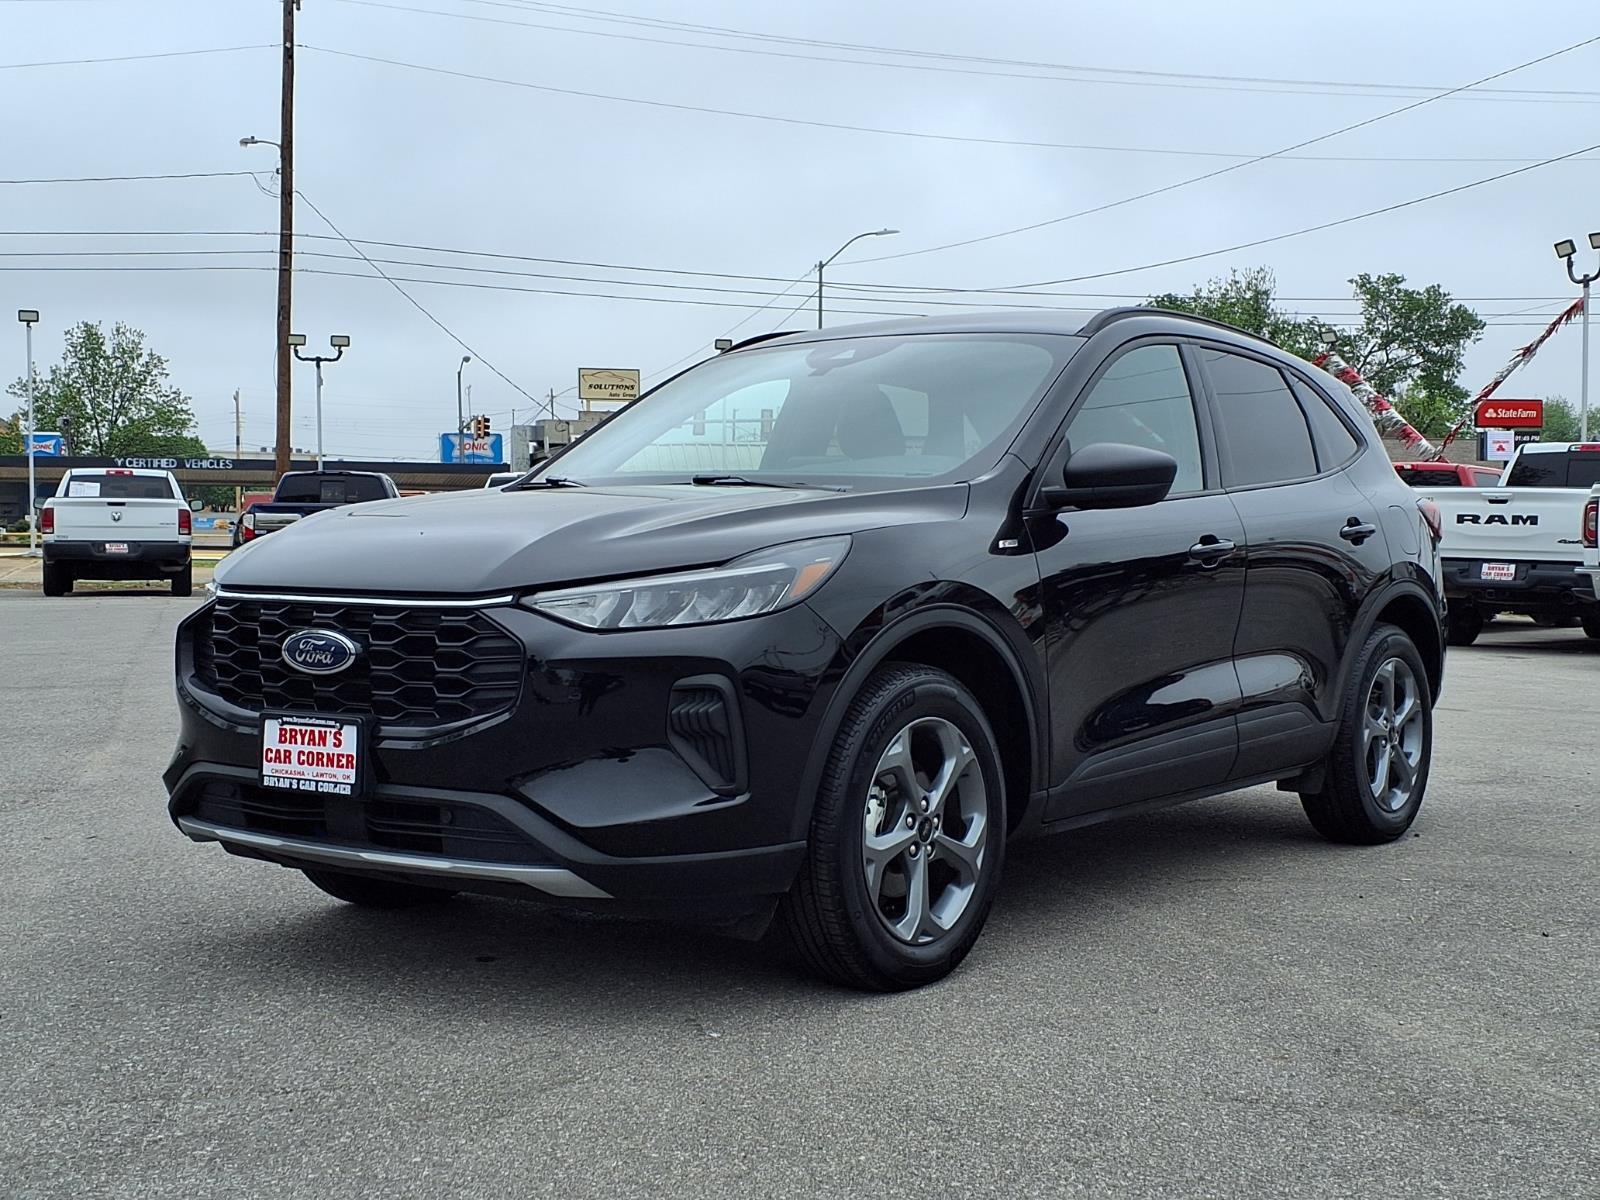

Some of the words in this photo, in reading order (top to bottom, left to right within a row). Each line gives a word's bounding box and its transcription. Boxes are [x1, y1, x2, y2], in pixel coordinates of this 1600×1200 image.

[125, 458, 177, 468] CERTIFIED
[185, 459, 233, 469] VEHICLES
[1456, 514, 1539, 525] RAM
[295, 638, 336, 664] Ford
[278, 727, 343, 748] BRYAN'S
[264, 748, 292, 765] CAR
[297, 750, 355, 769] CORNER
[270, 768, 305, 777] CHICKASHA
[263, 776, 298, 788] BRYAN'S
[300, 780, 316, 791] CAR
[317, 782, 351, 795] CORNER
